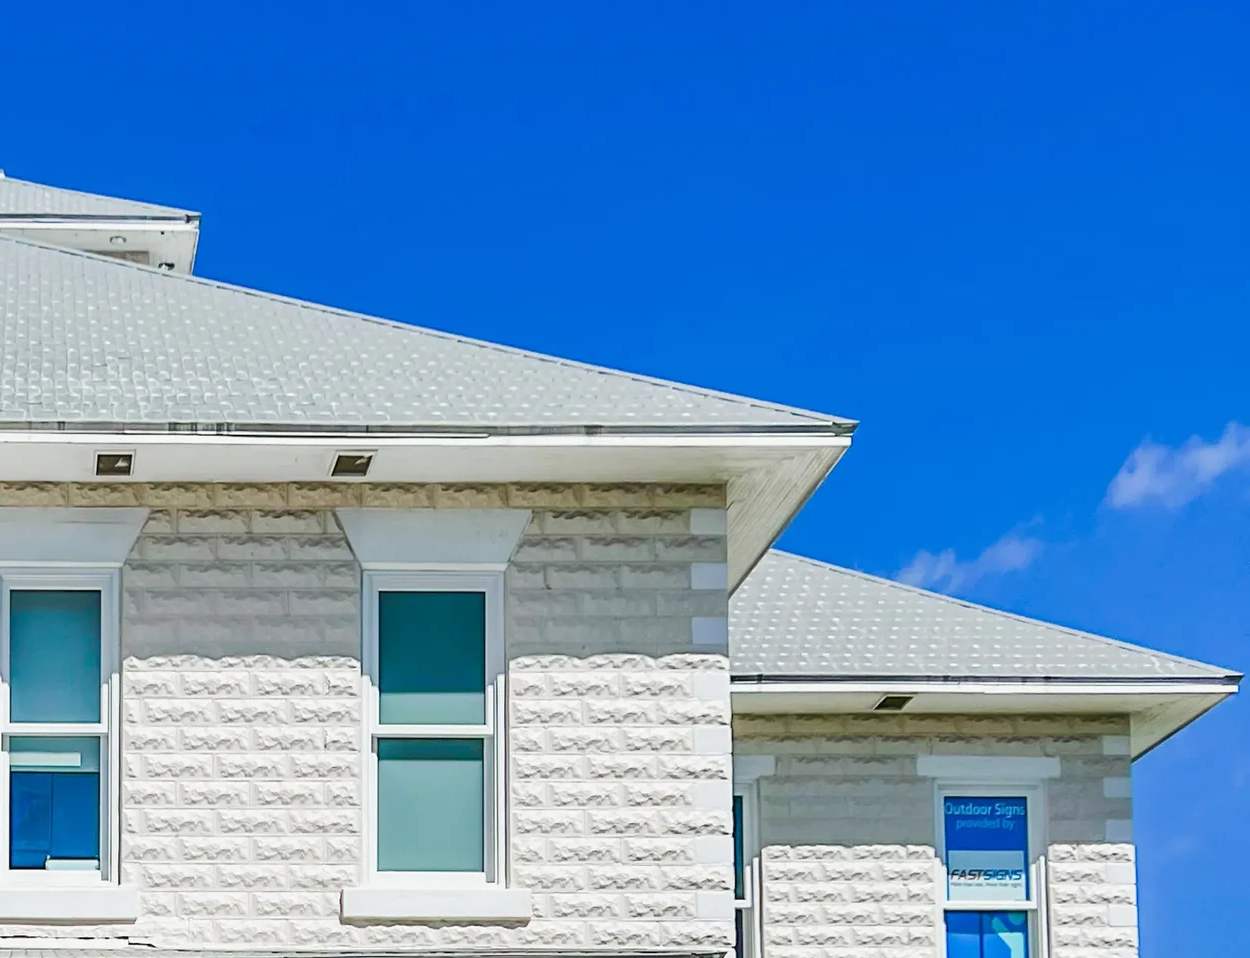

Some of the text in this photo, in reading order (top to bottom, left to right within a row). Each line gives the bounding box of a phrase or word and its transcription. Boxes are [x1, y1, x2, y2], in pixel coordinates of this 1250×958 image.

[945, 802, 1026, 819] Outdoor Signs
[956, 817, 1000, 832] provided
[950, 868, 1023, 880] FASTSIGNS
